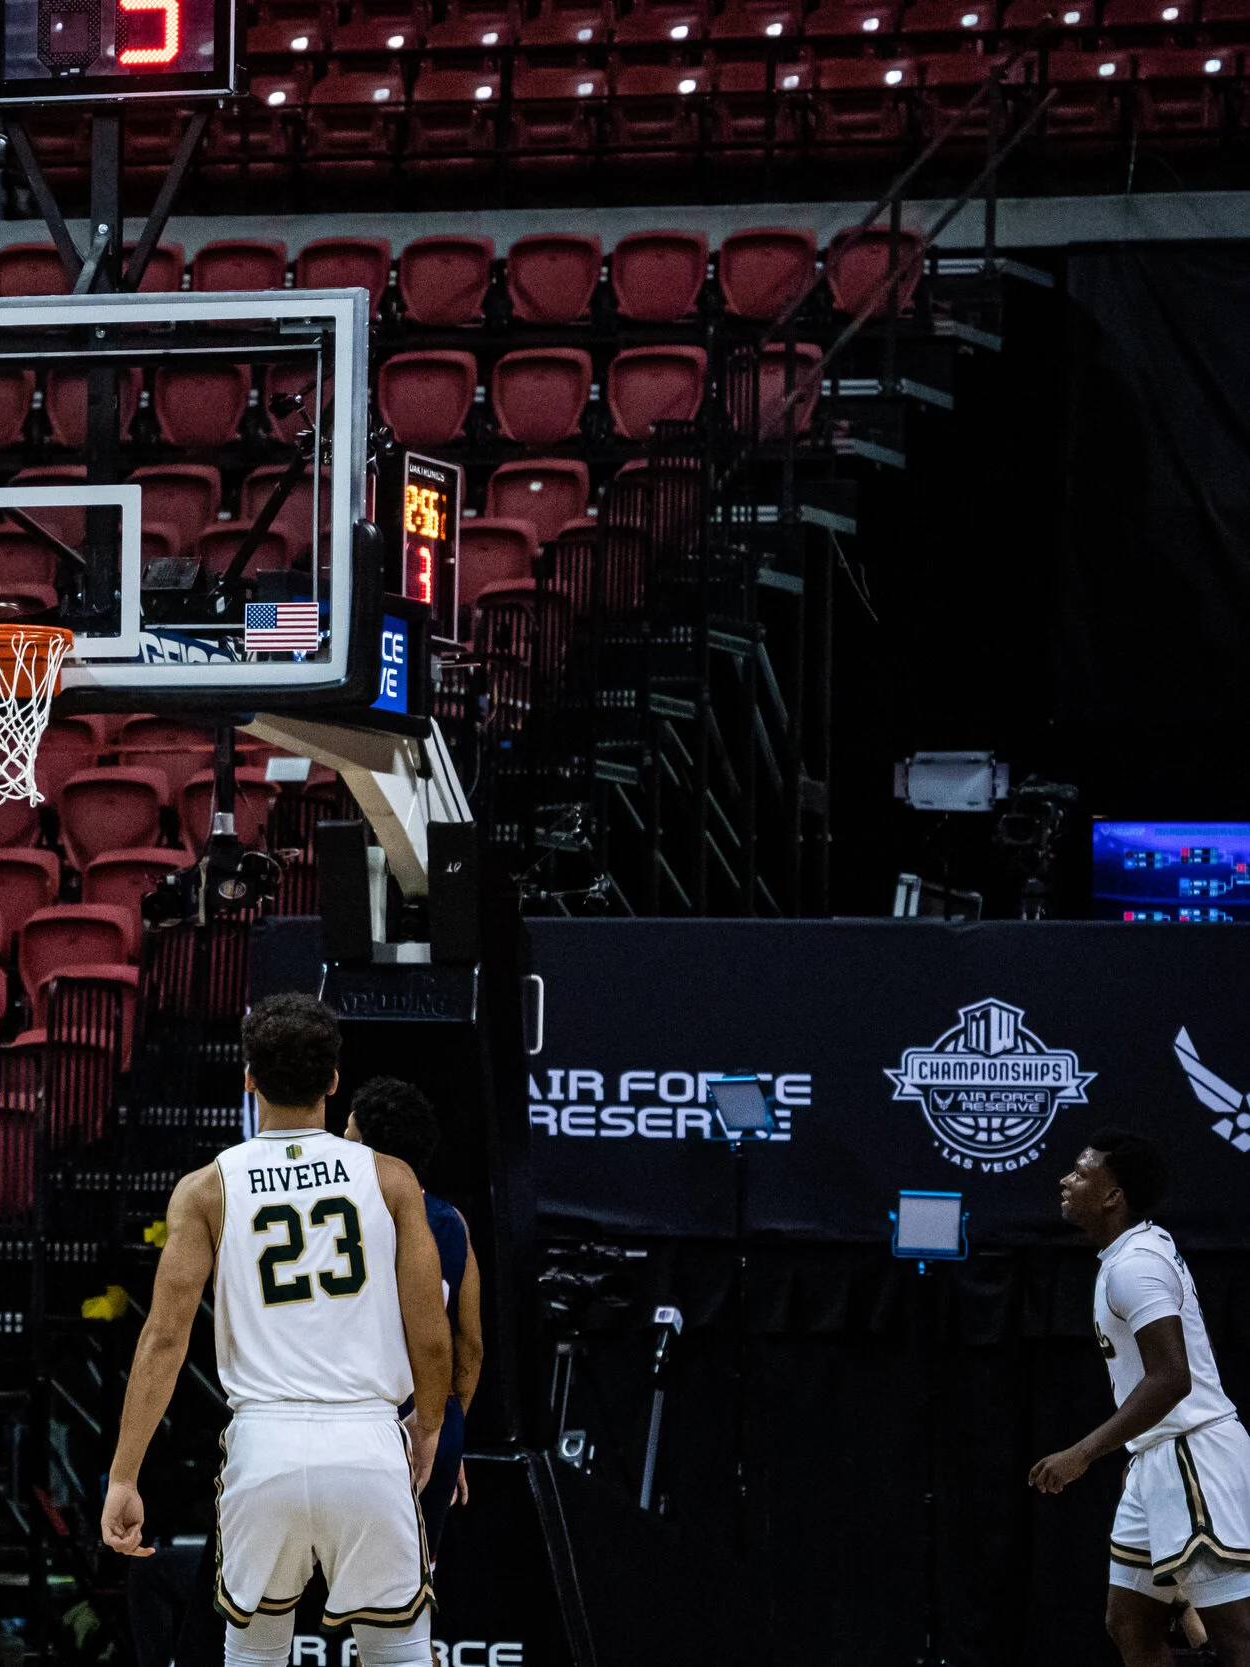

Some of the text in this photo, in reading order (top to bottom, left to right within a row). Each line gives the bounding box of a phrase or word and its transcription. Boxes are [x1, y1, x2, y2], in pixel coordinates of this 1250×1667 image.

[917, 1061, 1063, 1081] CHAMPIONSHIPS
[957, 1090, 1046, 1103] AIR FORCE
[962, 1102, 1040, 1113] RESERVE
[942, 1148, 1041, 1173] LAS VEGAS
[248, 1159, 351, 1194] RIVERA
[251, 1195, 369, 1308] 23
